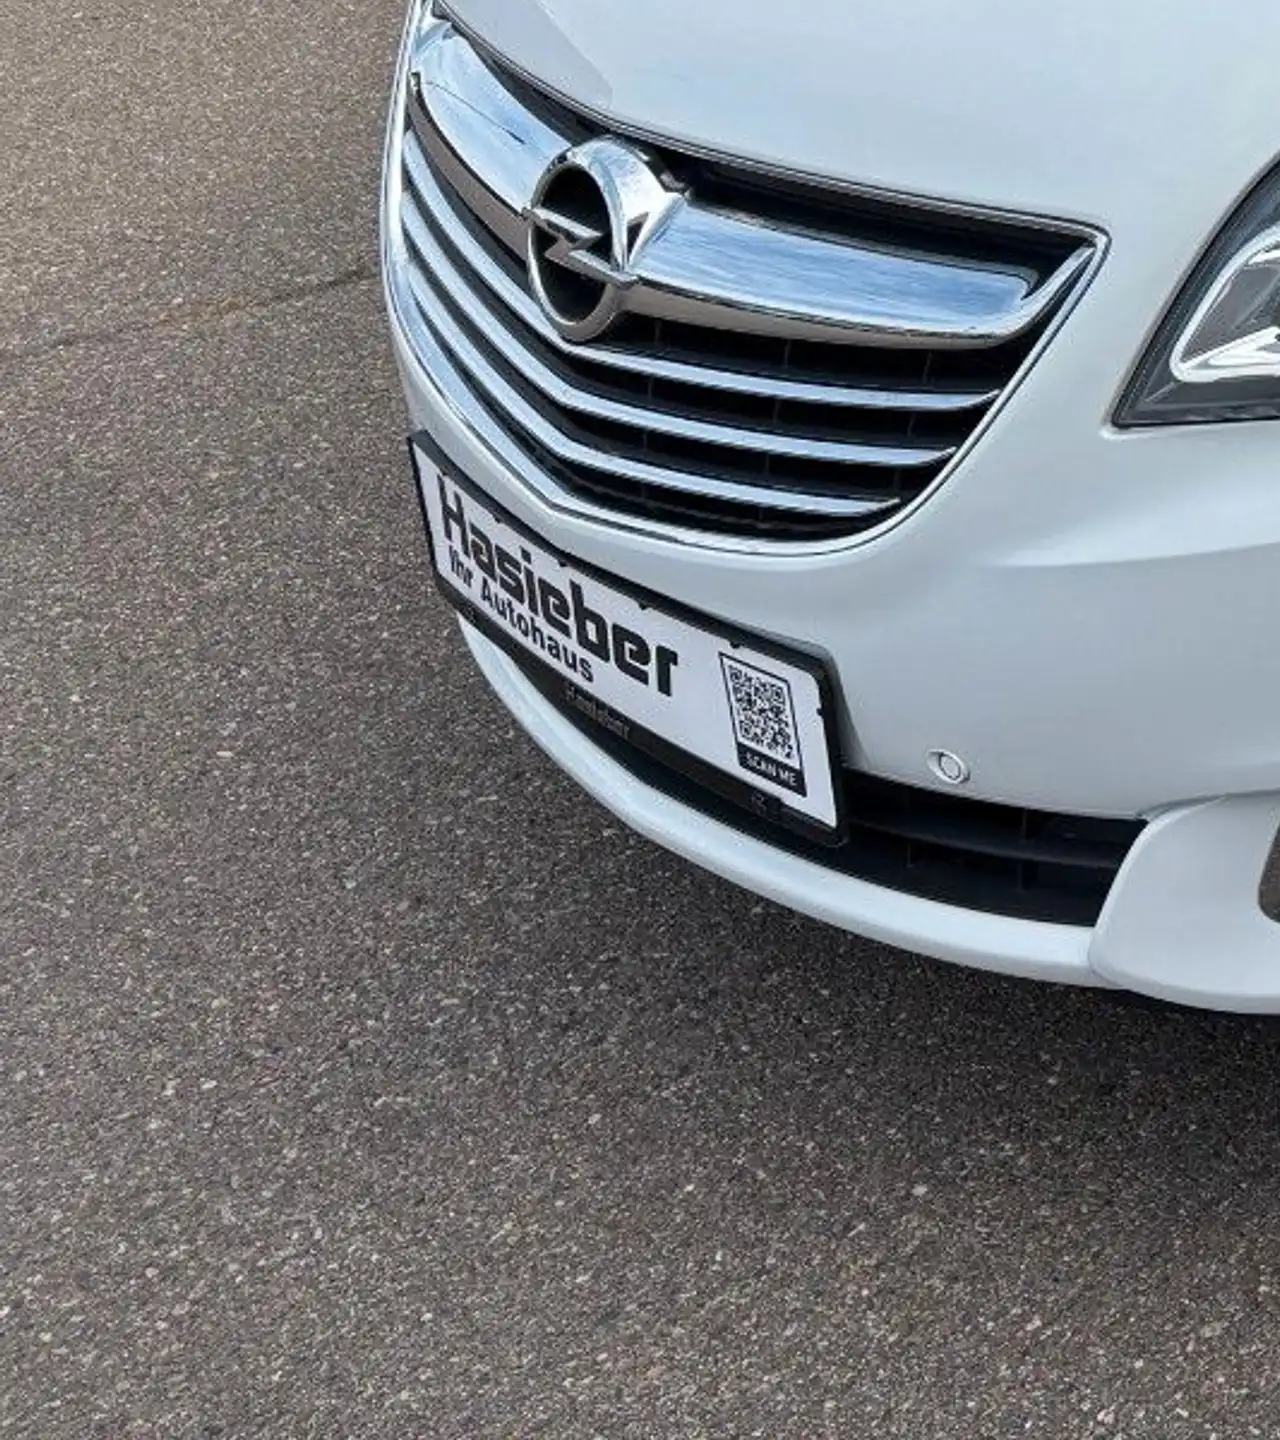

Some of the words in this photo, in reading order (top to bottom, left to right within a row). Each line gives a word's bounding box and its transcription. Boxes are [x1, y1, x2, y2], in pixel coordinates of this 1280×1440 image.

[437, 473, 679, 697] Hasieber
[480, 576, 594, 683] Autohaus
[744, 751, 777, 777] SCAN
[778, 766, 797, 787] ME
